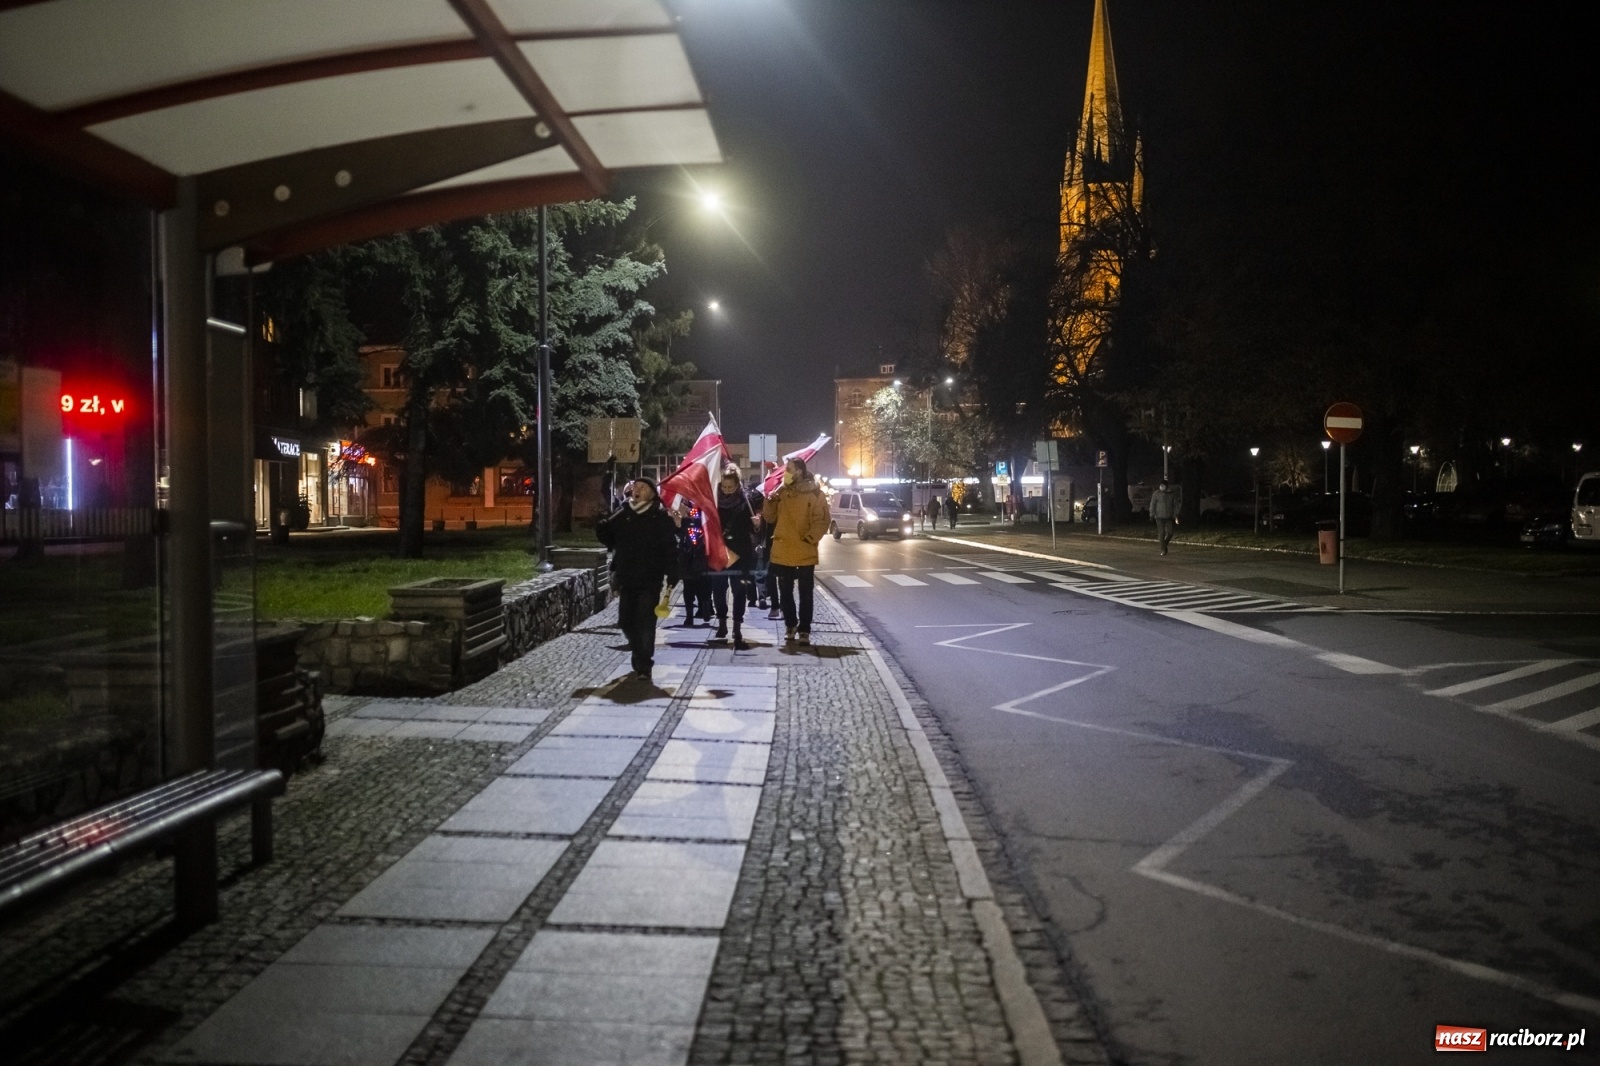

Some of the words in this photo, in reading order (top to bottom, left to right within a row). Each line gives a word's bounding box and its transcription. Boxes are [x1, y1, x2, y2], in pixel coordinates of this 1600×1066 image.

[61, 394, 74, 412] 9
[80, 395, 106, 416] zł,
[998, 461, 1006, 471] P
